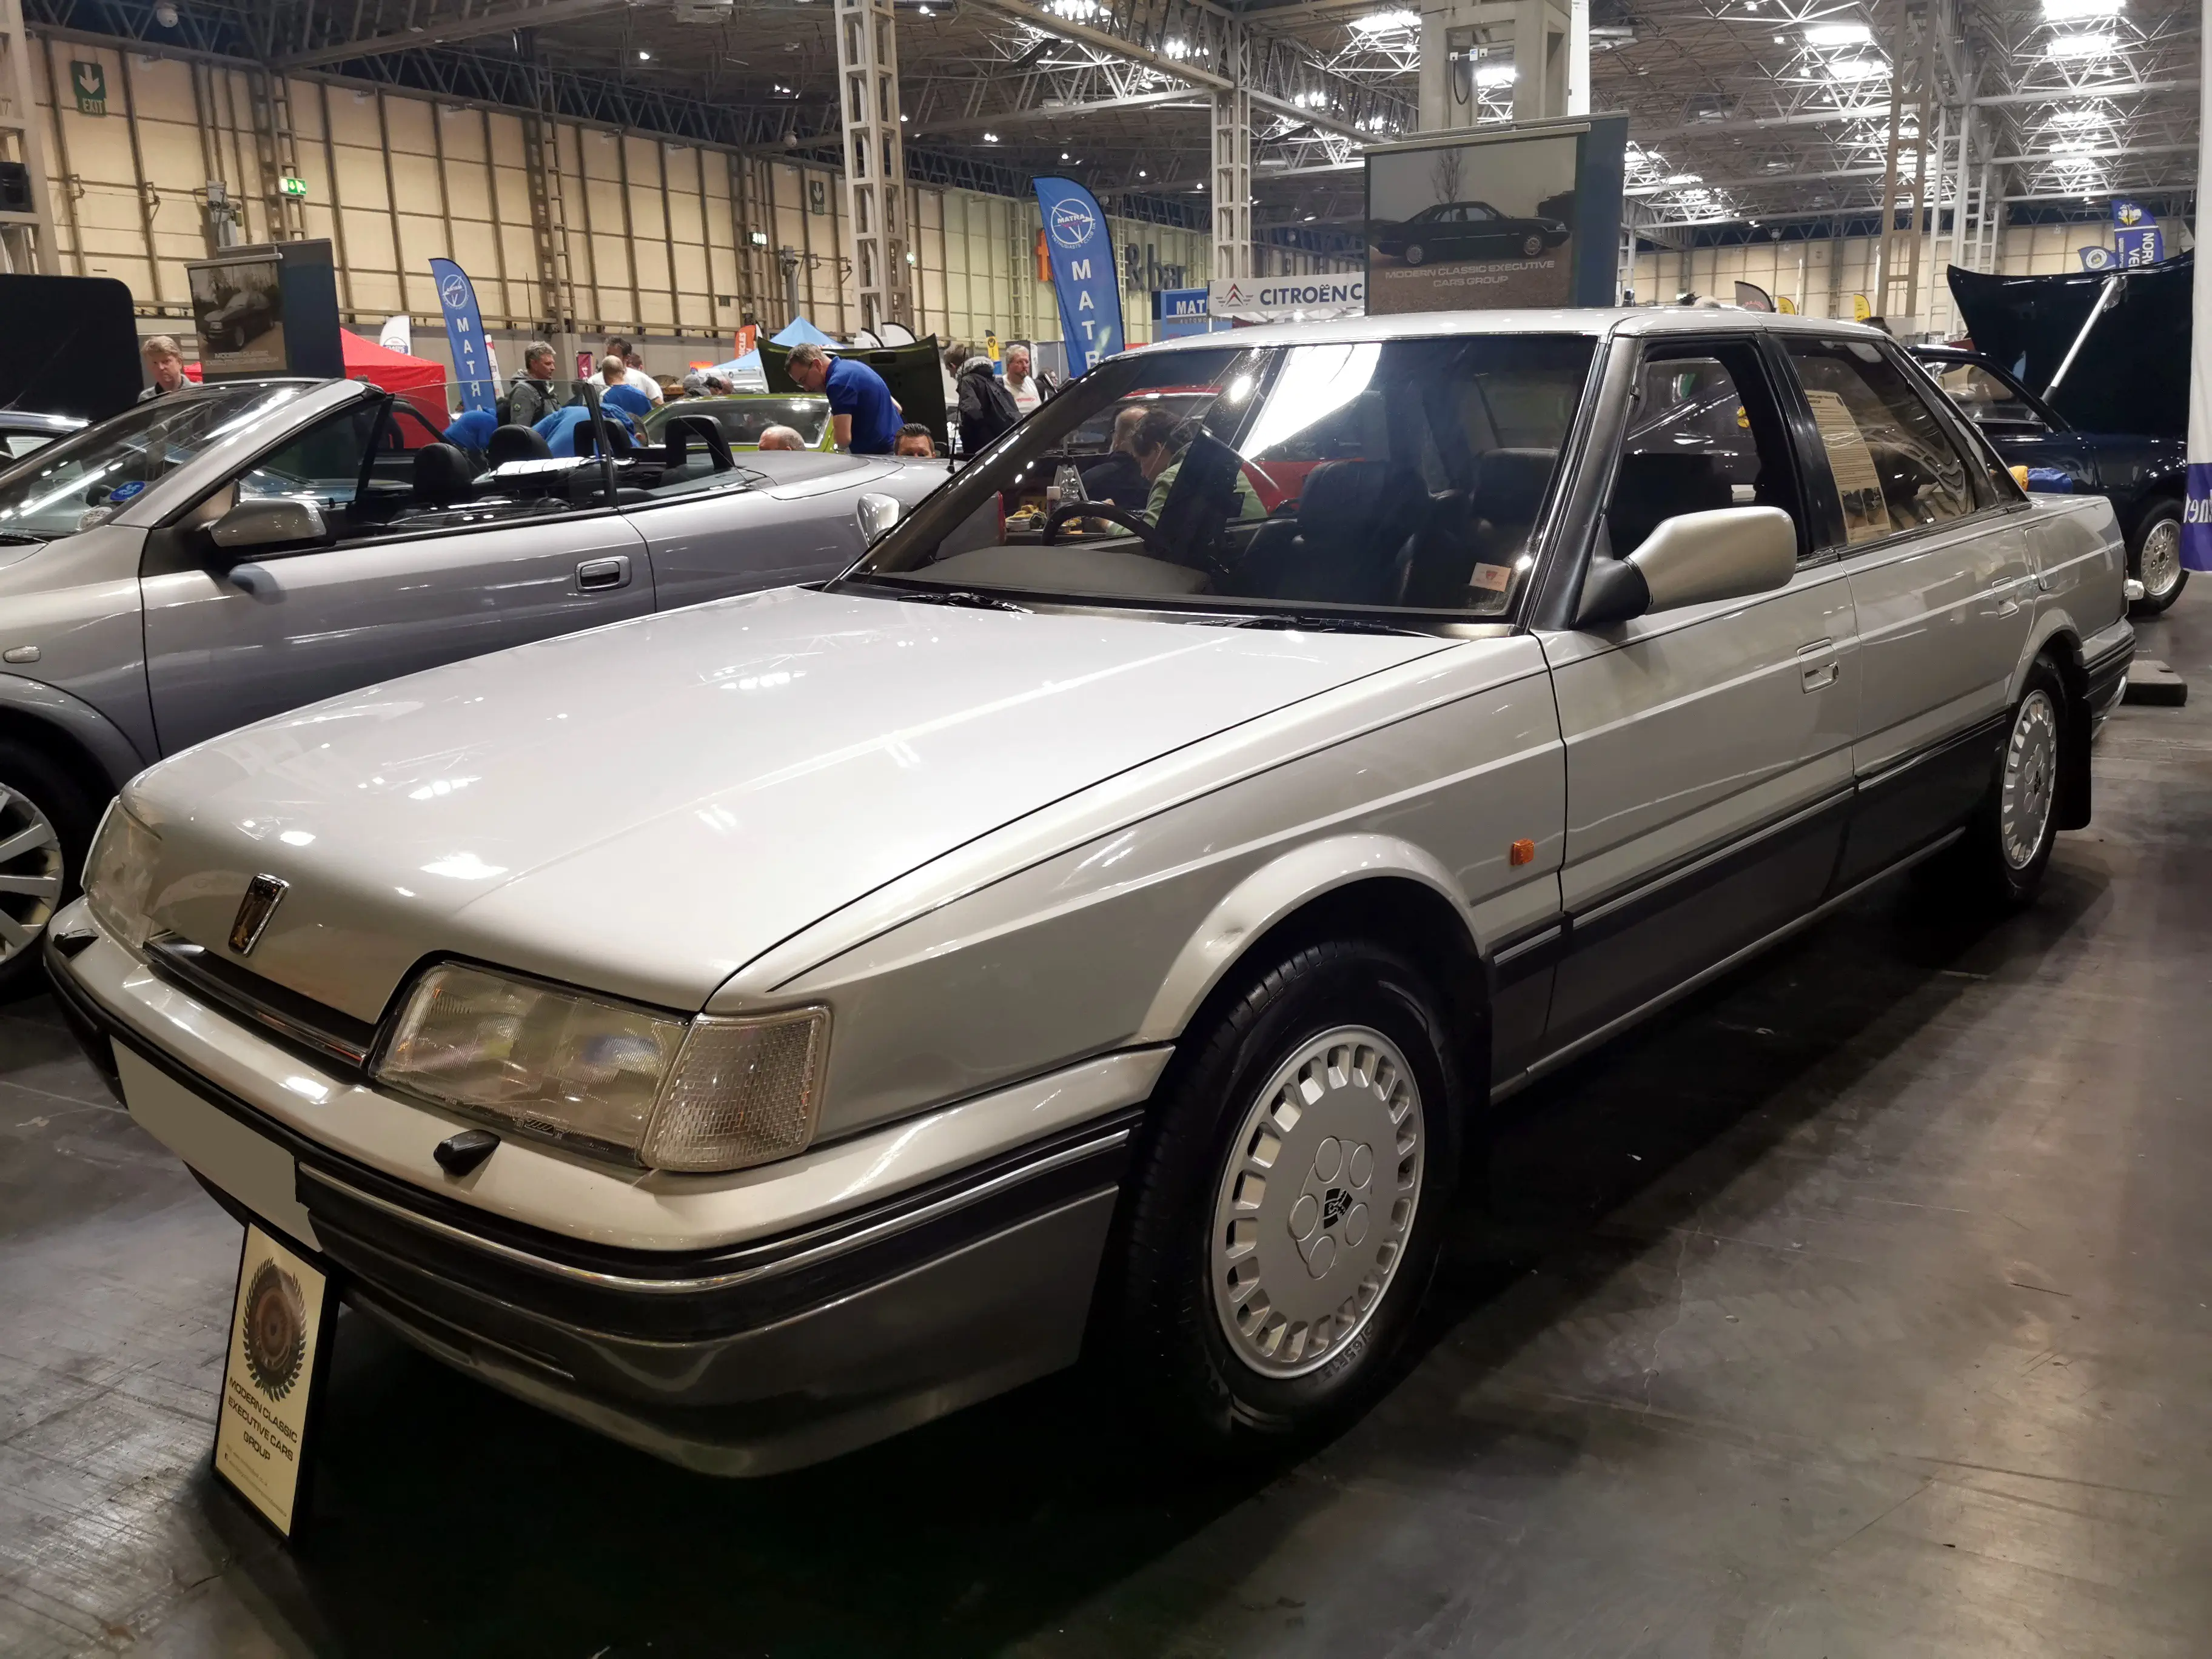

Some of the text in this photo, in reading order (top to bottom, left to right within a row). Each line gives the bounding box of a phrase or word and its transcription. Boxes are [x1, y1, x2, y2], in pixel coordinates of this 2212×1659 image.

[82, 98, 103, 113] EXIT
[1057, 214, 1085, 224] MATRA
[1147, 244, 1187, 292] bar
[1386, 260, 1555, 280] MODERN CLASSIC EXECUTIVE
[1433, 275, 1509, 288] CARS GROUP
[1259, 283, 1364, 306] CITROËN C
[1176, 299, 1207, 315] MAT
[229, 1376, 298, 1444] MODERN CLASSIC
[228, 1395, 294, 1462] EXECUTIVE CARS
[243, 1430, 270, 1461] GROUP
